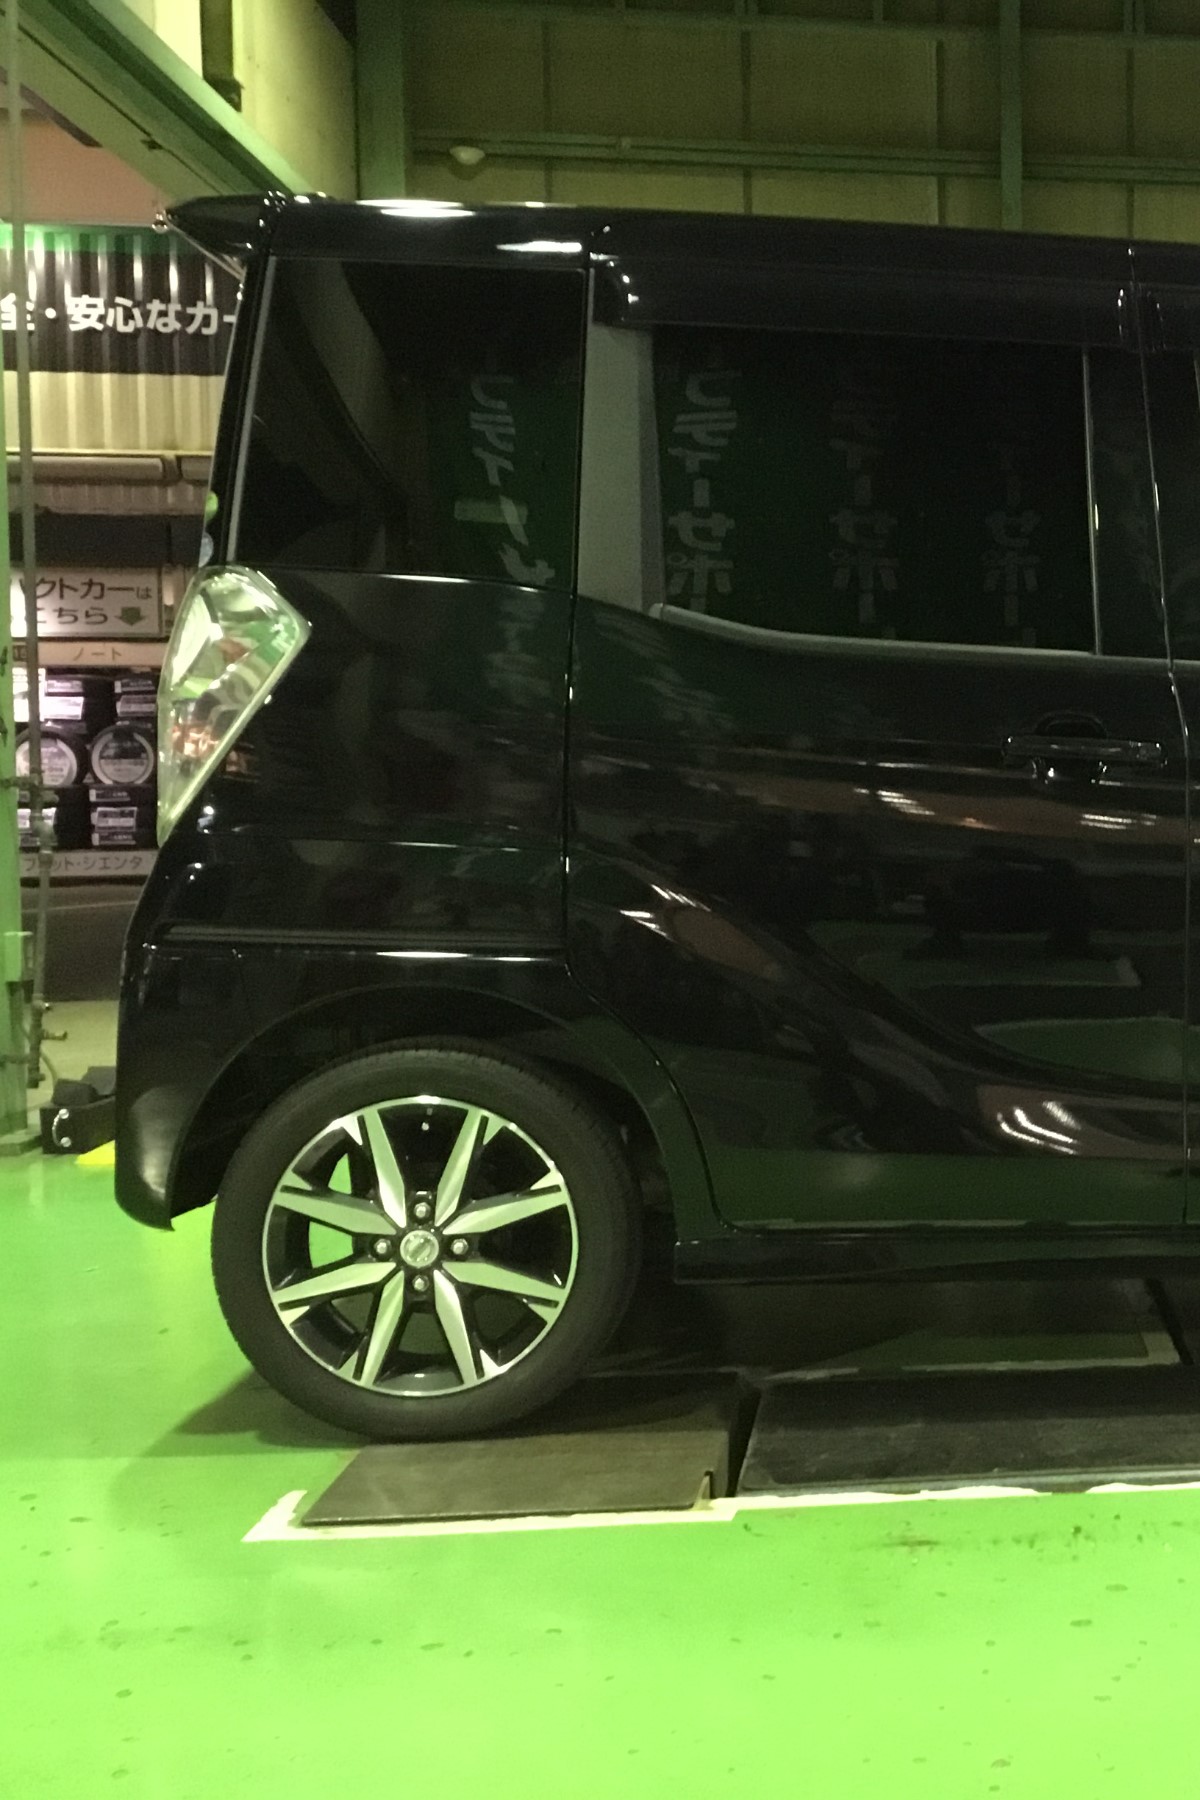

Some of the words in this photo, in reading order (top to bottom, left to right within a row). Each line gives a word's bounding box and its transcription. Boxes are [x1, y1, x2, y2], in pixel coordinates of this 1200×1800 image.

[21, 577, 153, 601] クトカーは
[73, 647, 123, 661] ノート
[22, 854, 144, 872] フット・シエンタ
